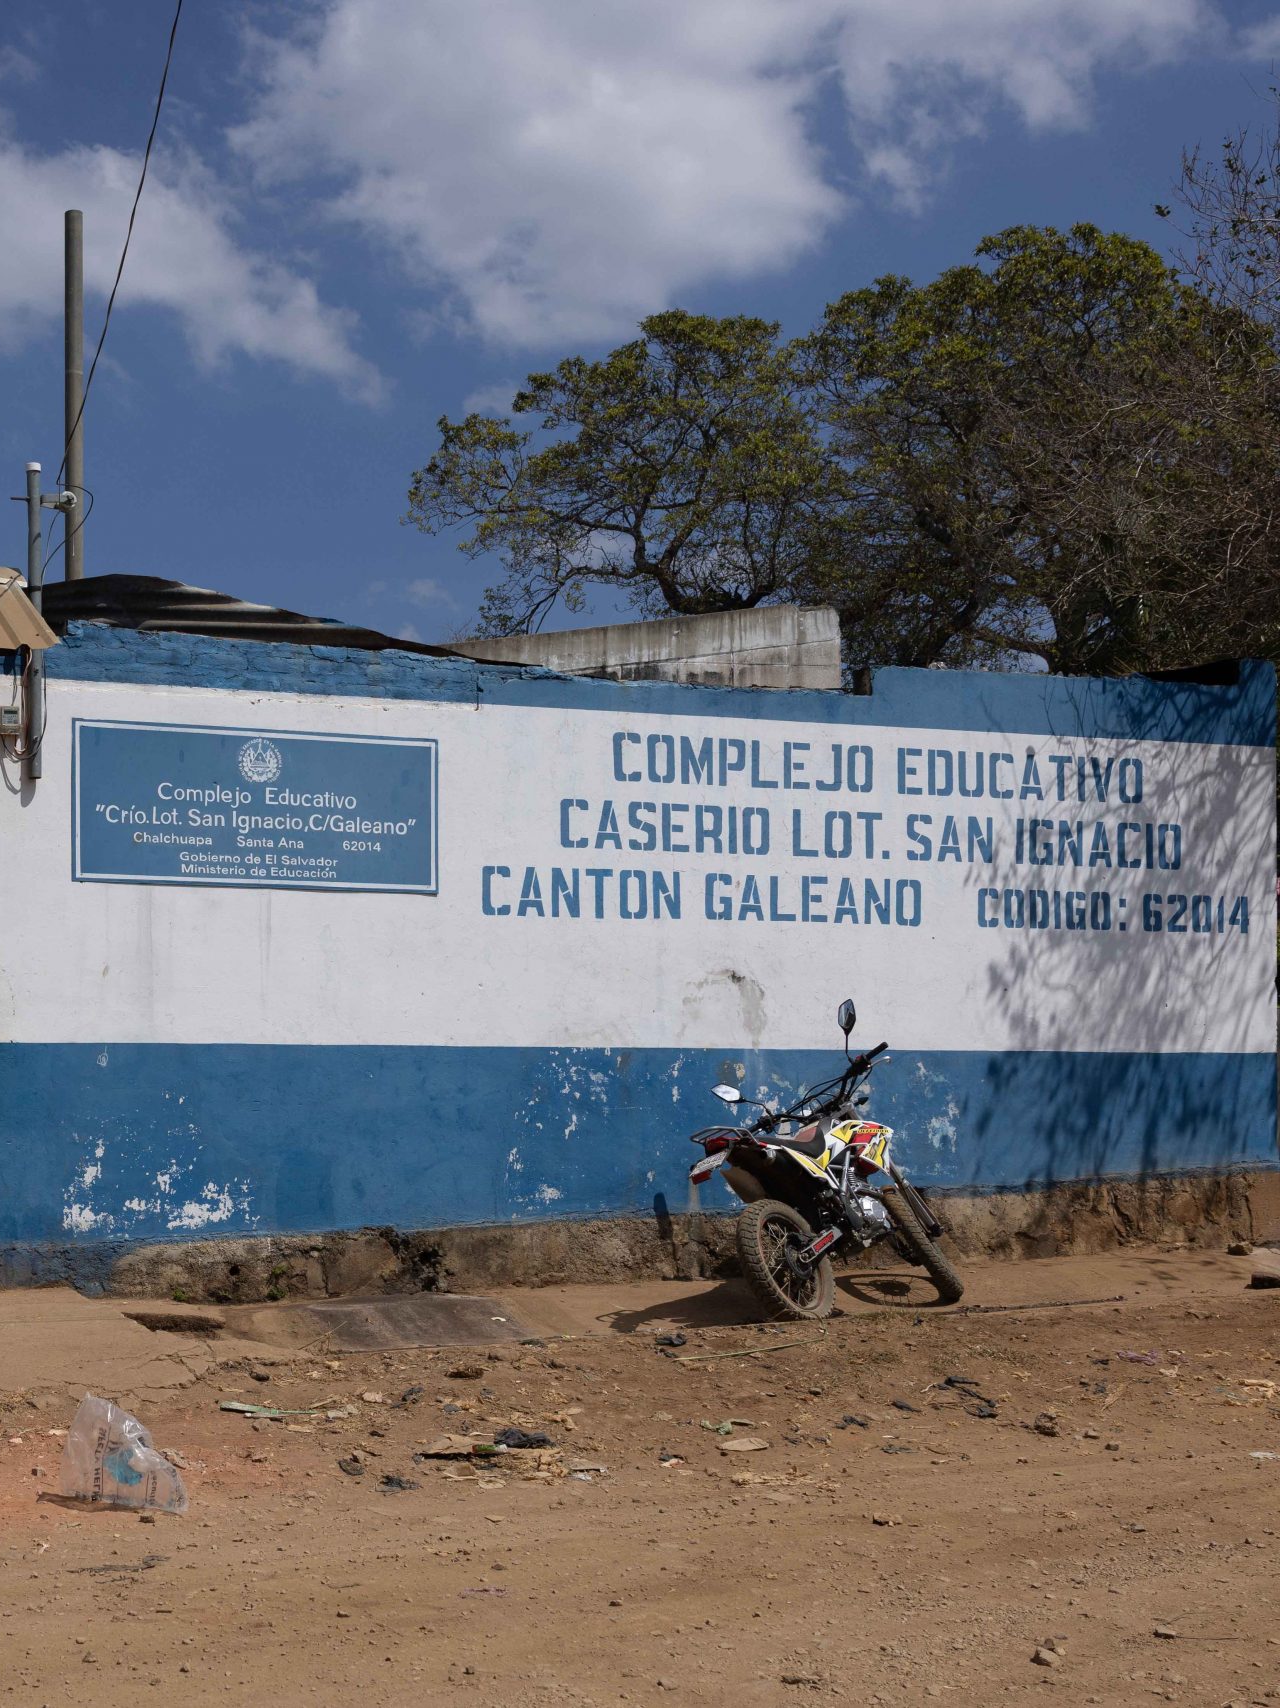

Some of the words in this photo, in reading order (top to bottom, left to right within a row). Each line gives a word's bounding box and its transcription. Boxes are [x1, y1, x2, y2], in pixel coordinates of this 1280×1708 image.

[612, 731, 874, 793] COMPLEJO
[897, 746, 1144, 804] EDUCATIVO
[157, 782, 252, 808] Complejo
[265, 787, 357, 810] Educativo
[188, 809, 226, 827] San
[133, 831, 213, 847] Chalchuapa
[236, 836, 274, 849] Santa
[277, 837, 304, 849] Ana
[342, 840, 382, 852] 62014
[559, 798, 770, 856] CASERIO
[792, 808, 891, 860] LOT.
[906, 813, 994, 864] SAN
[1015, 818, 1182, 871] IGNACIO
[179, 851, 241, 864] Gobierno
[244, 853, 261, 865] de
[265, 854, 278, 866] El
[281, 855, 339, 868] Salvador
[180, 864, 246, 876] Ministerio
[250, 866, 267, 877] de
[271, 866, 337, 880] Educación
[481, 865, 681, 920] CANTON
[704, 872, 922, 927] GALEANO
[977, 887, 1127, 931] CODIGO:
[1142, 893, 1250, 934] 62014
